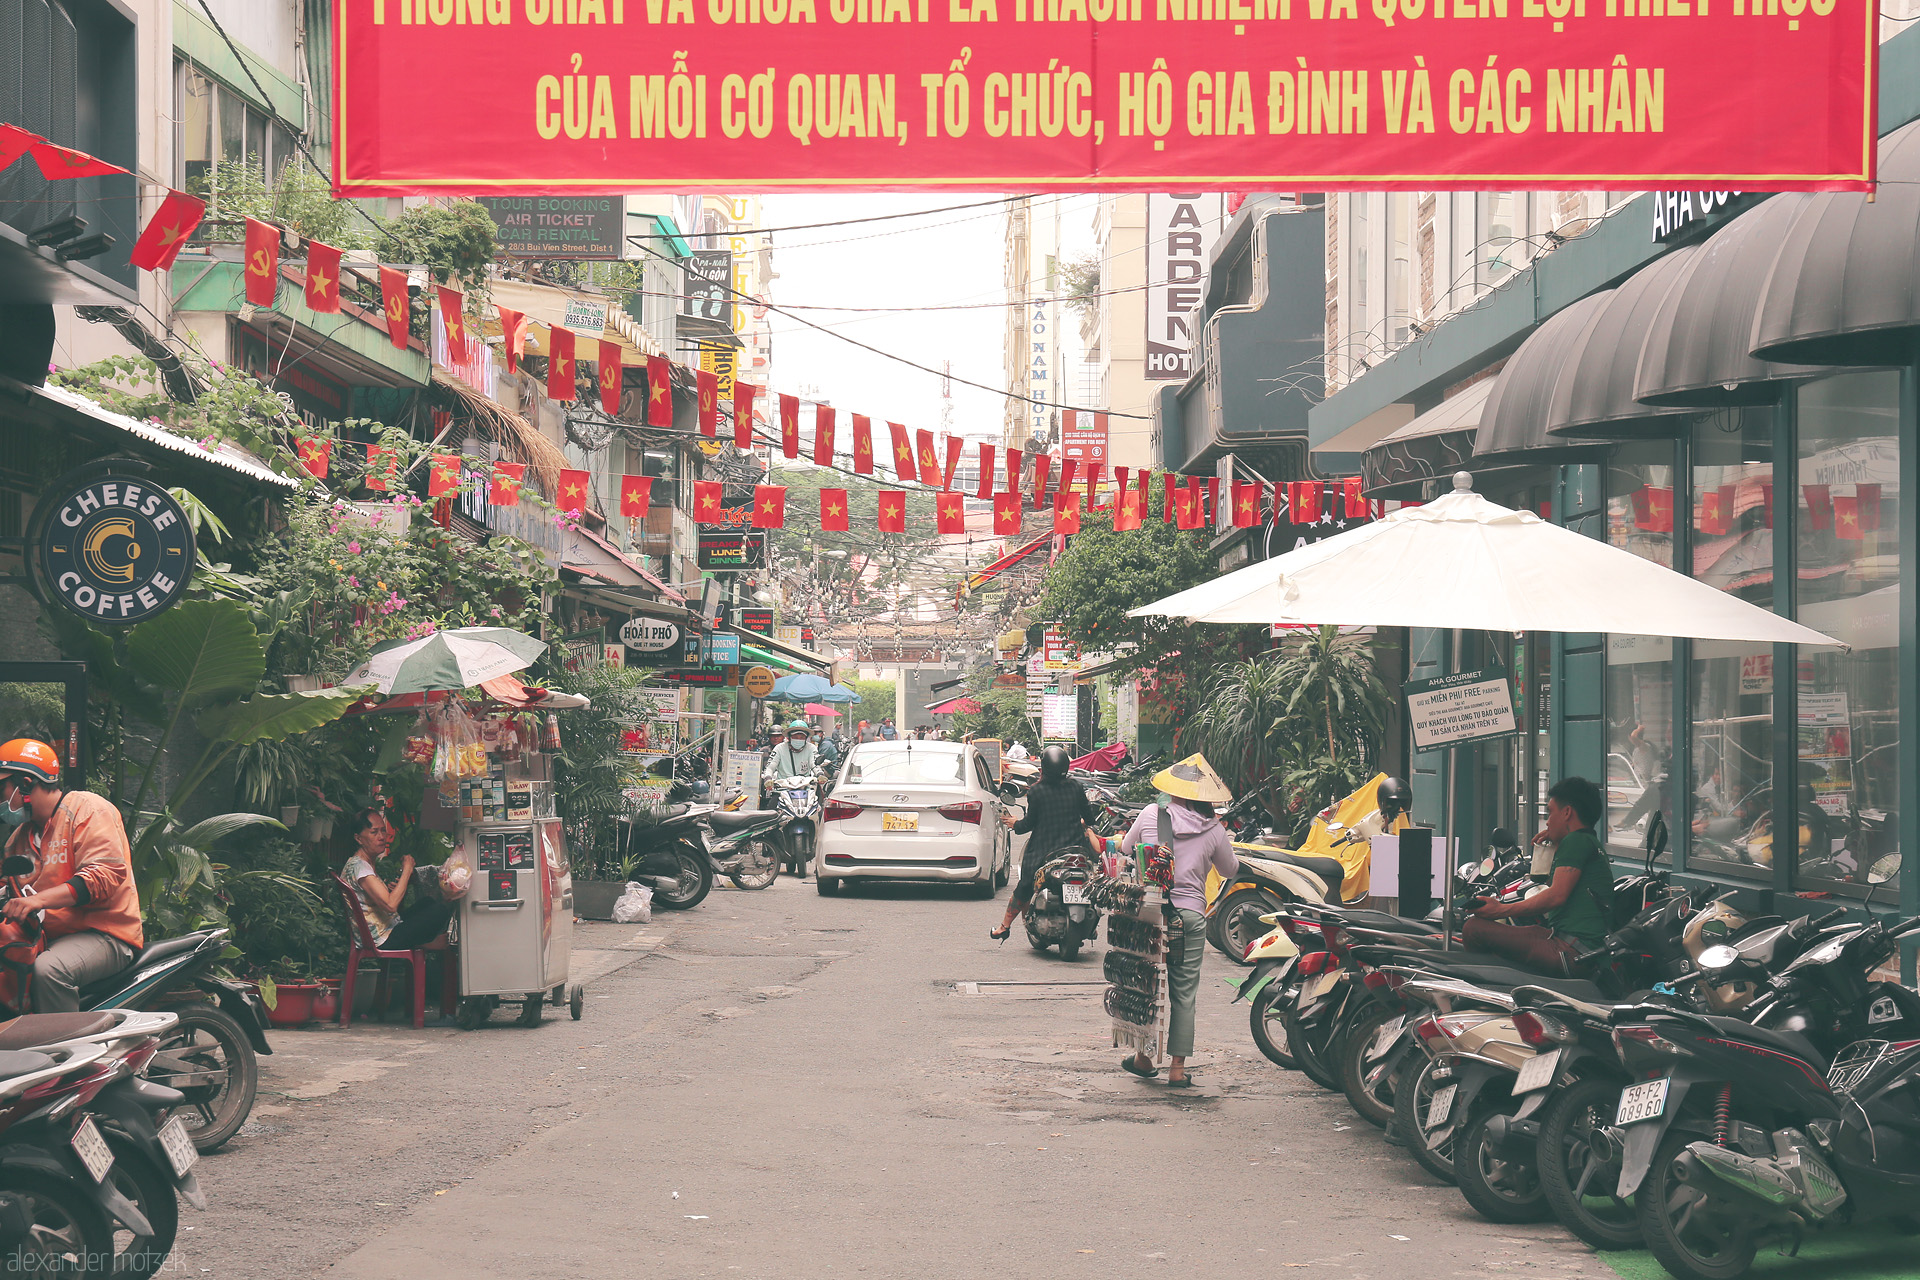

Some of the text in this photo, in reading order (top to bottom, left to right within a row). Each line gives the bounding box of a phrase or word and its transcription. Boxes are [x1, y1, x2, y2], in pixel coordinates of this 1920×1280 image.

[535, 46, 1665, 151] CỦA MỖI CƠ QUAN, TỔ CHỨC, HỘ GIA ĐÌNH VÀ CÁC NHÂN
[490, 198, 611, 212] TOUR BOOKING
[504, 213, 595, 226] AIR TICKET
[498, 228, 600, 241] CAR RENTAL
[508, 243, 525, 251] 28/3
[60, 483, 177, 531] CHEESE
[59, 571, 176, 617] COFFEE
[652, 623, 672, 639] PHỐ
[1445, 671, 1482, 683] GOURMET
[1464, 687, 1481, 698] FREE
[1627, 1082, 1661, 1103] 59-F2
[1619, 1099, 1661, 1123] 089.60
